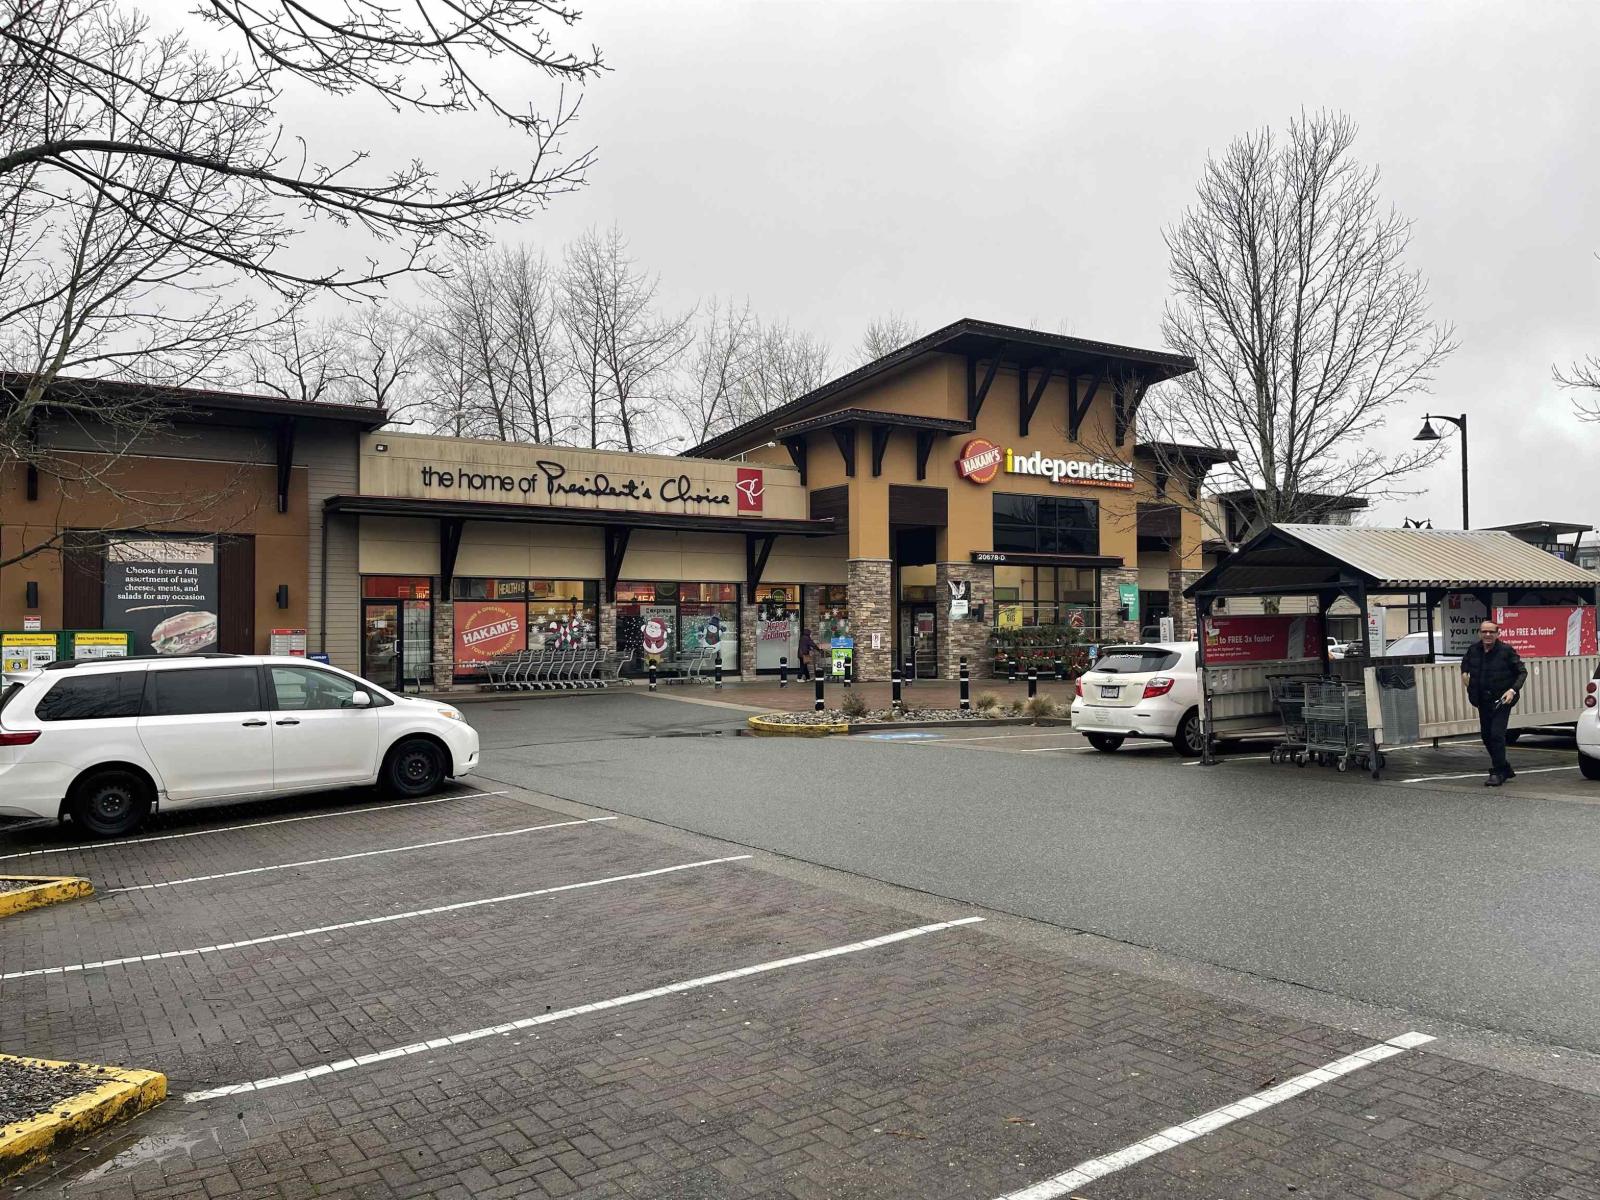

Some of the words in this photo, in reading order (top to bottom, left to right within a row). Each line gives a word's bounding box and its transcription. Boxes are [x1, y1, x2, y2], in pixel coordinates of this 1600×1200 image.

[963, 449, 1001, 473] HAKAM'S
[1006, 447, 1135, 482] independent
[421, 466, 454, 488] the
[458, 467, 515, 492] home
[518, 473, 539, 494] of
[535, 460, 652, 499] President's
[659, 474, 730, 504] Choice
[977, 553, 1006, 561] 20678-D
[126, 566, 156, 574] Choose
[157, 566, 176, 575] from
[184, 567, 198, 575] full
[170, 575, 180, 583] of
[180, 577, 199, 585] tasty
[124, 584, 156, 592] cheeses,
[184, 584, 199, 592] and
[117, 592, 142, 600] salads
[143, 592, 156, 600] for
[156, 594, 171, 602] any
[1449, 615, 1466, 624] We
[462, 620, 519, 644] HAKAM'S
[1450, 628, 1468, 638] you
[1508, 628, 1515, 637] to
[1515, 627, 1529, 636] FREE
[1530, 627, 1537, 636] 3x
[1219, 636, 1227, 645] to
[1227, 635, 1243, 644] FREE
[1244, 635, 1253, 644] 3x
